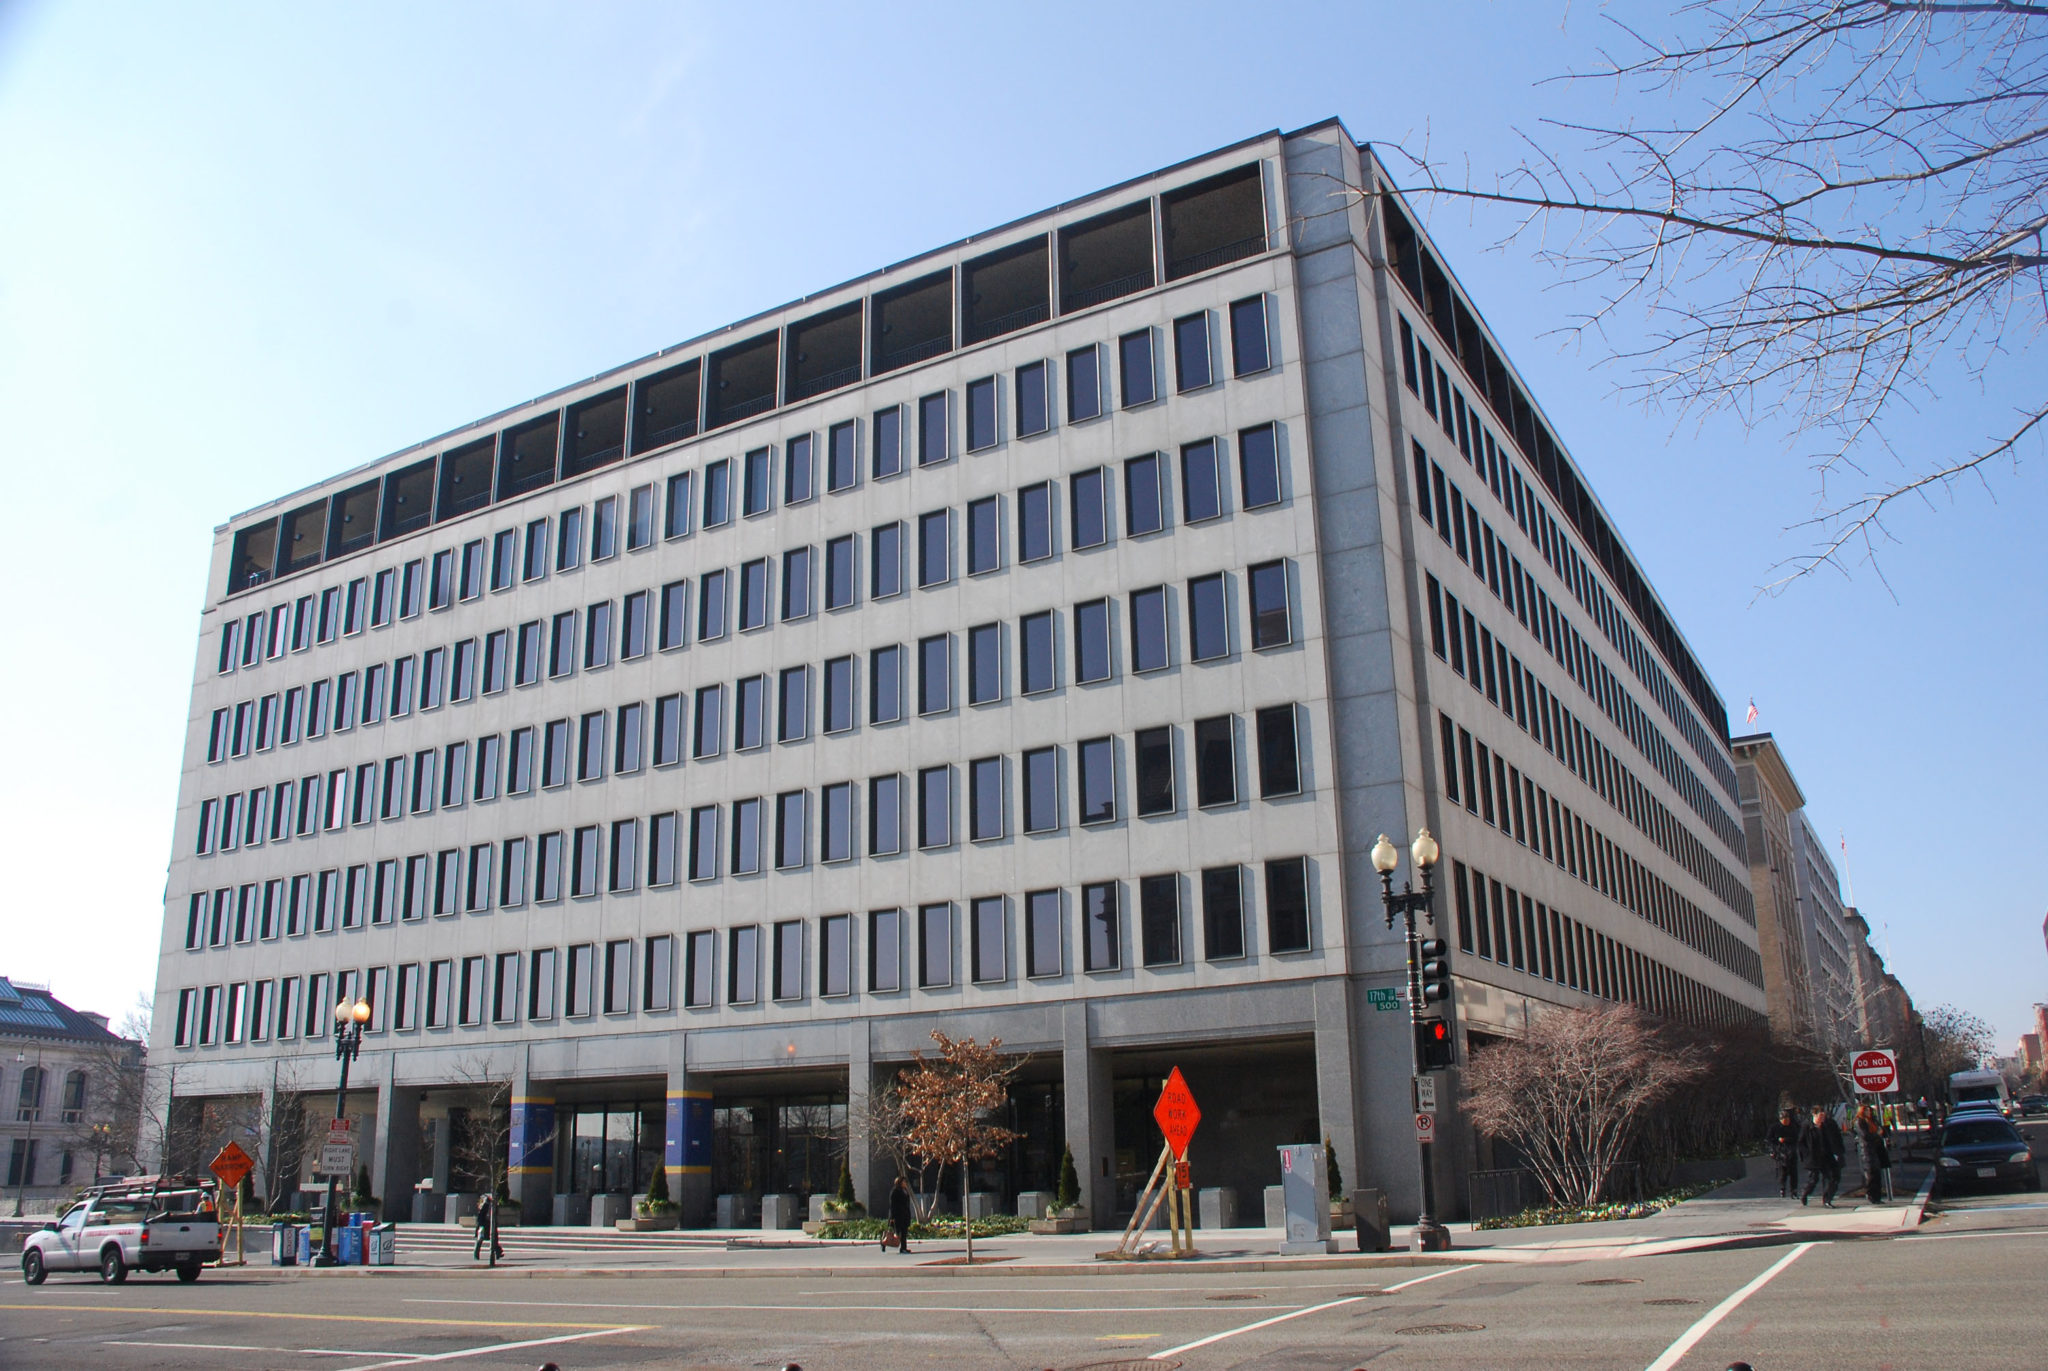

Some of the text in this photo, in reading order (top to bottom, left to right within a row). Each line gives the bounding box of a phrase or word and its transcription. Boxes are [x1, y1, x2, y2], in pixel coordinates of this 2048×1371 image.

[1370, 990, 1386, 1002] 17th
[1379, 1001, 1398, 1010] 500
[1872, 1058, 1888, 1066] NOT
[1420, 1079, 1433, 1088] ONE
[1862, 1076, 1888, 1085] ENTER
[1168, 1092, 1186, 1104] ROAD
[1421, 1089, 1433, 1097] WAY
[1168, 1109, 1187, 1120] WORK
[1170, 1125, 1187, 1136] AHEAD
[1178, 1165, 1187, 1178] 15
